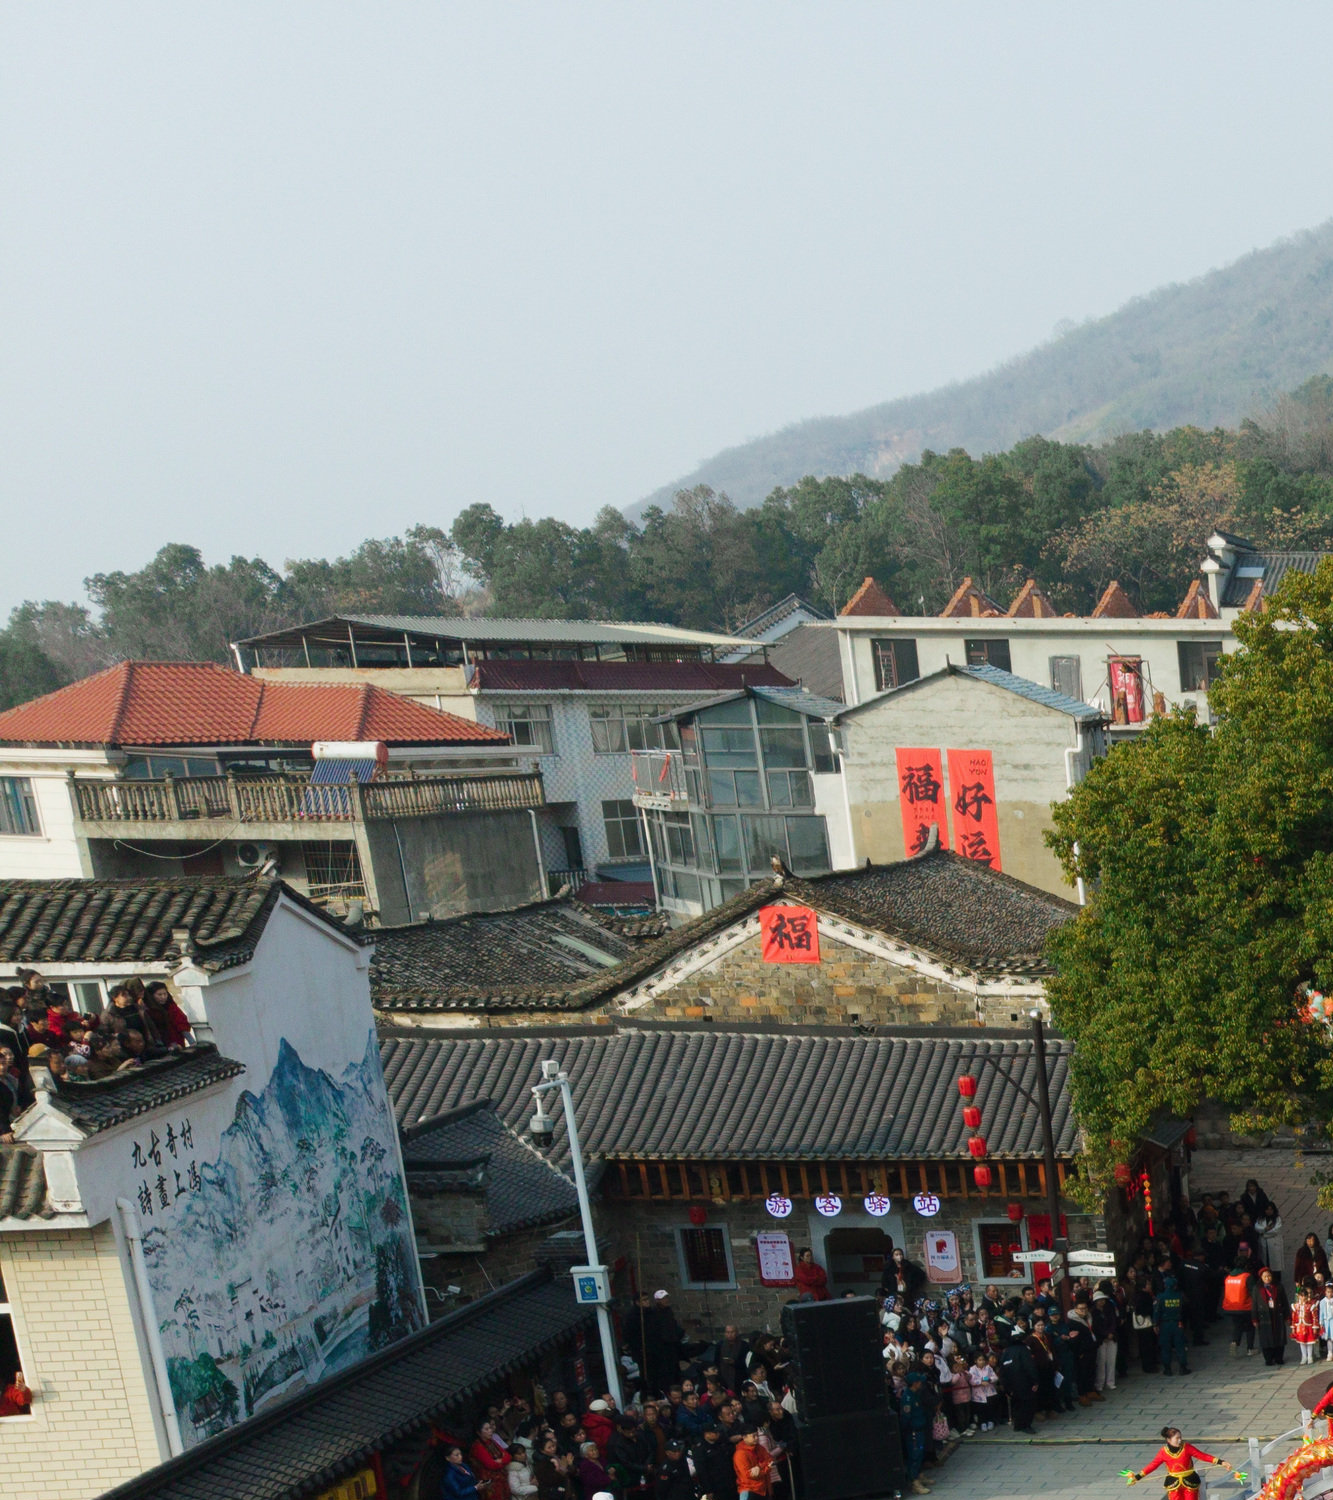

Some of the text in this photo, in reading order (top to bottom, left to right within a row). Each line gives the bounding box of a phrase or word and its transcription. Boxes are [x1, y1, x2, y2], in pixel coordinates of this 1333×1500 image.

[770, 913, 812, 951] 福
[764, 1193, 941, 1218] 游客驿站
